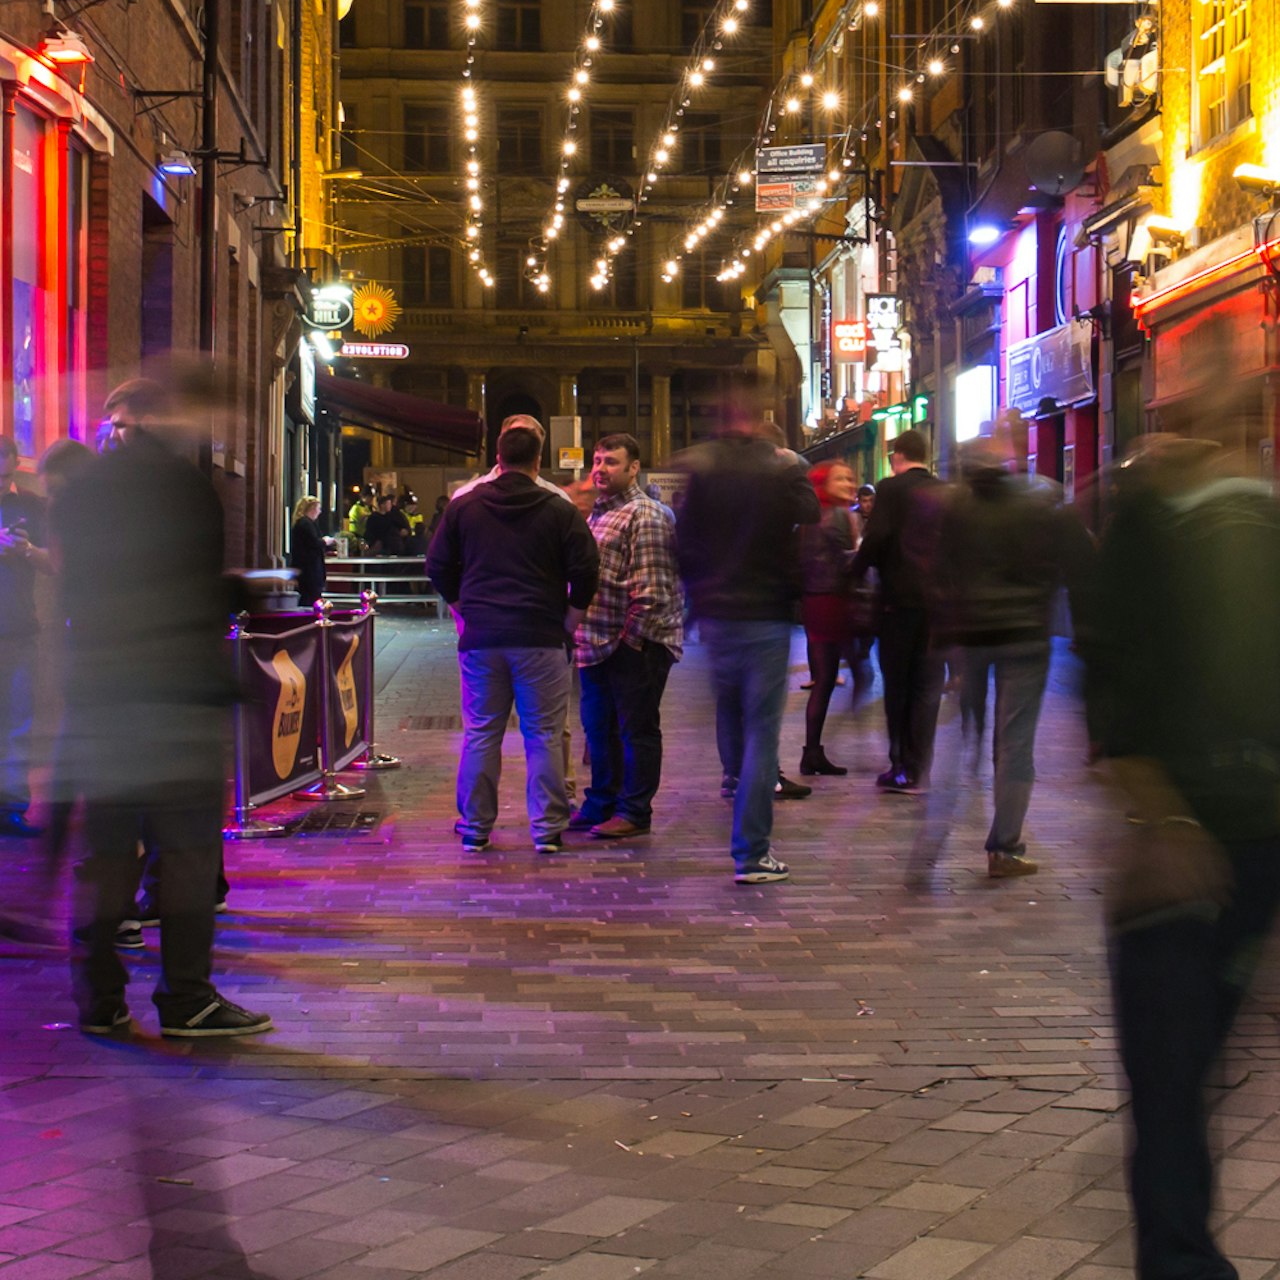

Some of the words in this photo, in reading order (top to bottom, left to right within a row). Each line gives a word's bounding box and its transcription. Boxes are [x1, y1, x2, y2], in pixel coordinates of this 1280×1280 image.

[778, 155, 817, 166] enquiries
[313, 310, 341, 323] HILL
[342, 345, 403, 357] REVOLUTION
